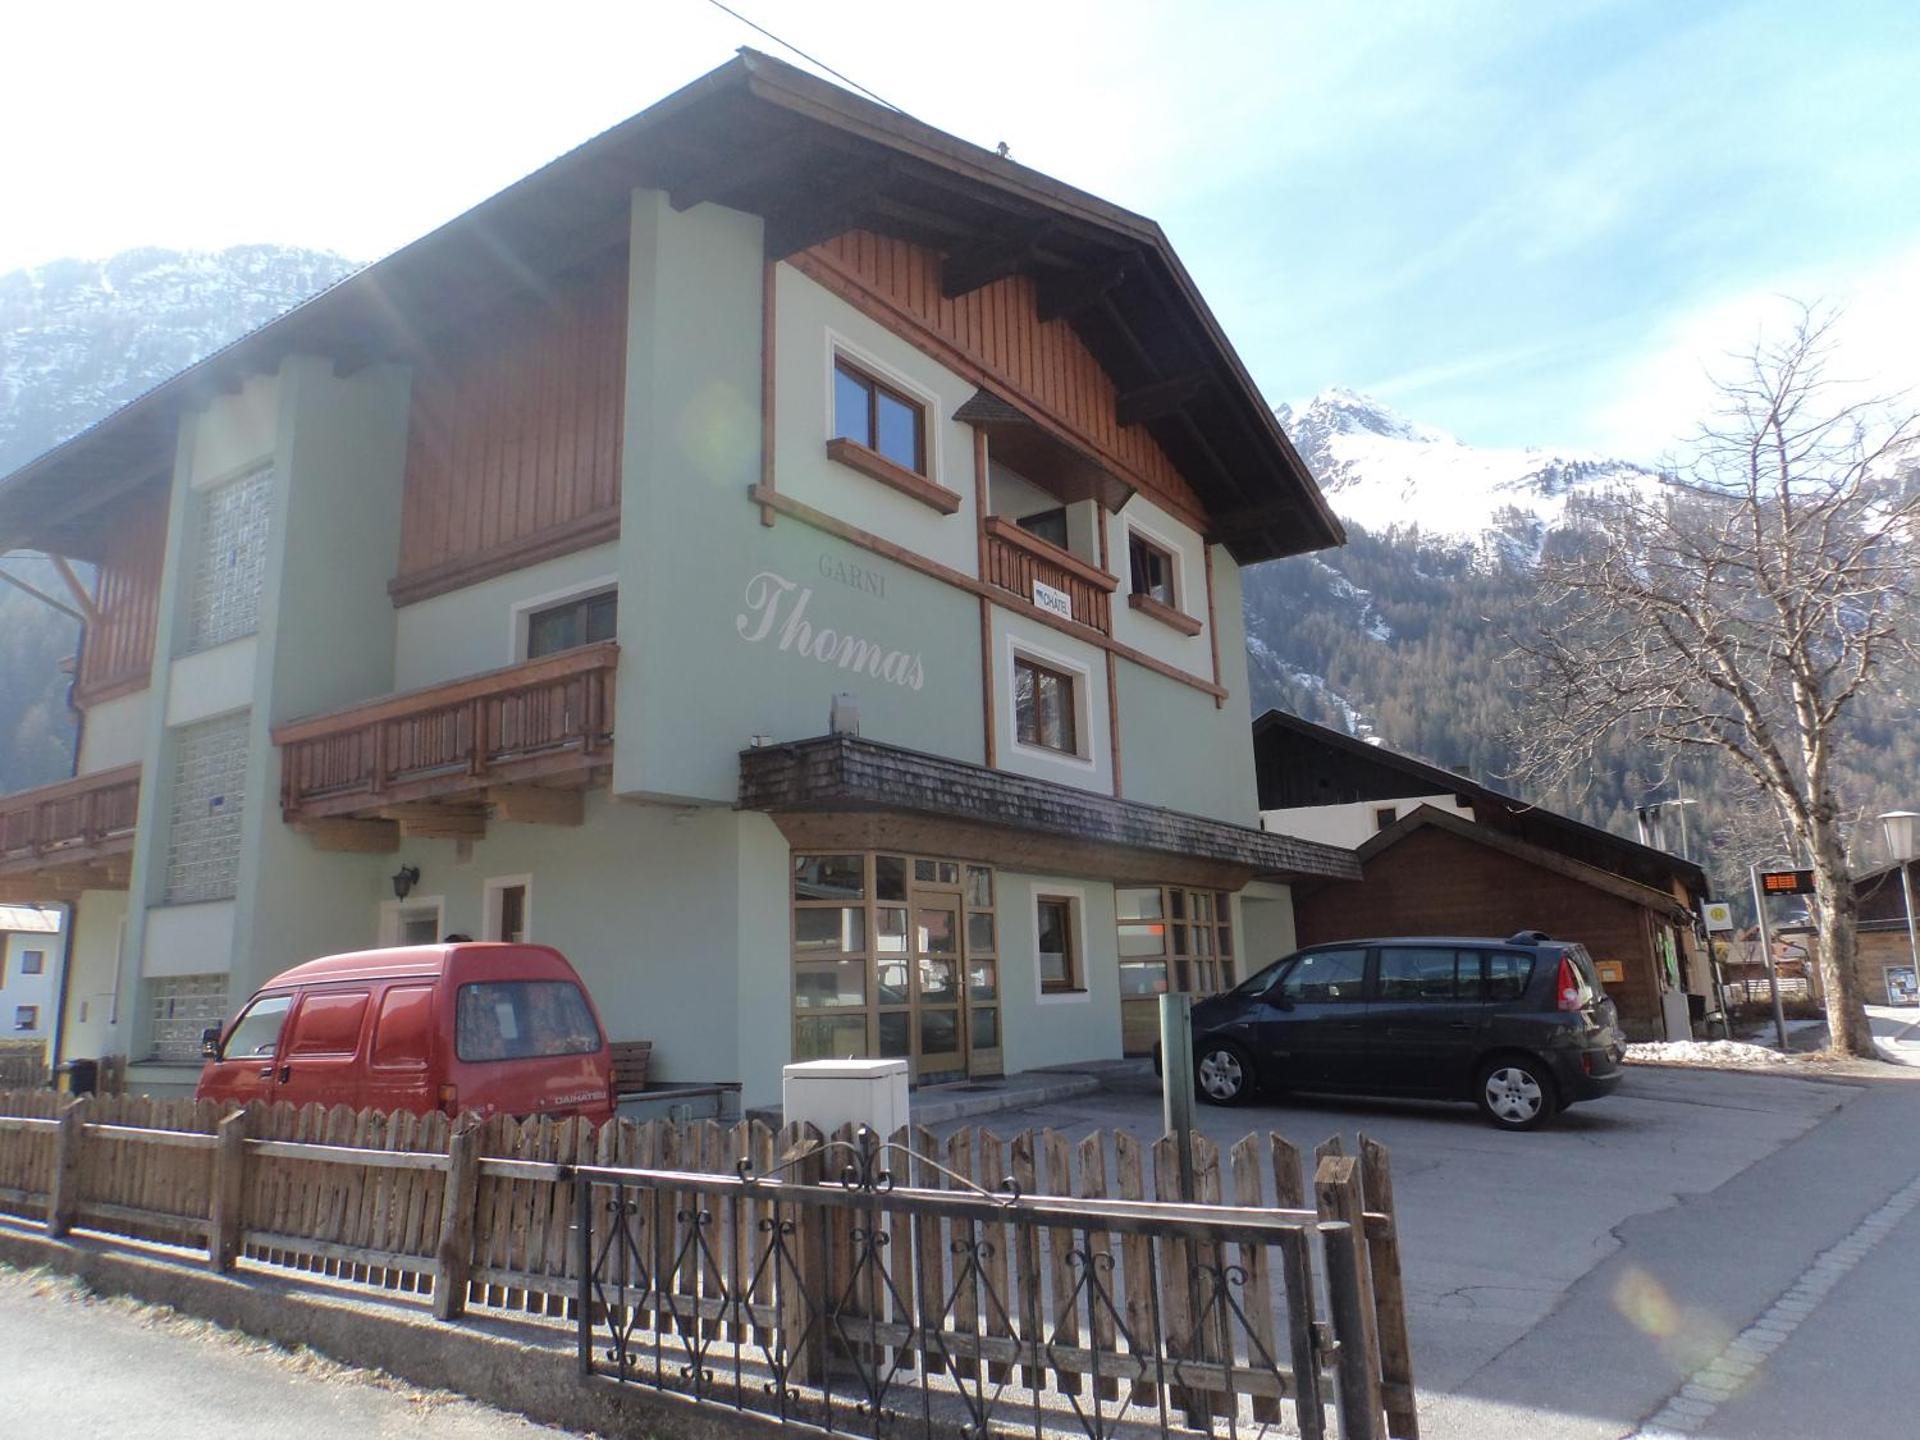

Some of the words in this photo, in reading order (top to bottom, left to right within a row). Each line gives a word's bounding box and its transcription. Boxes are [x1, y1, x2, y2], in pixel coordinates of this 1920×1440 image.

[819, 553, 887, 599] GARNI
[736, 571, 924, 691] Thomas
[555, 1091, 606, 1105] DAIHATSU
